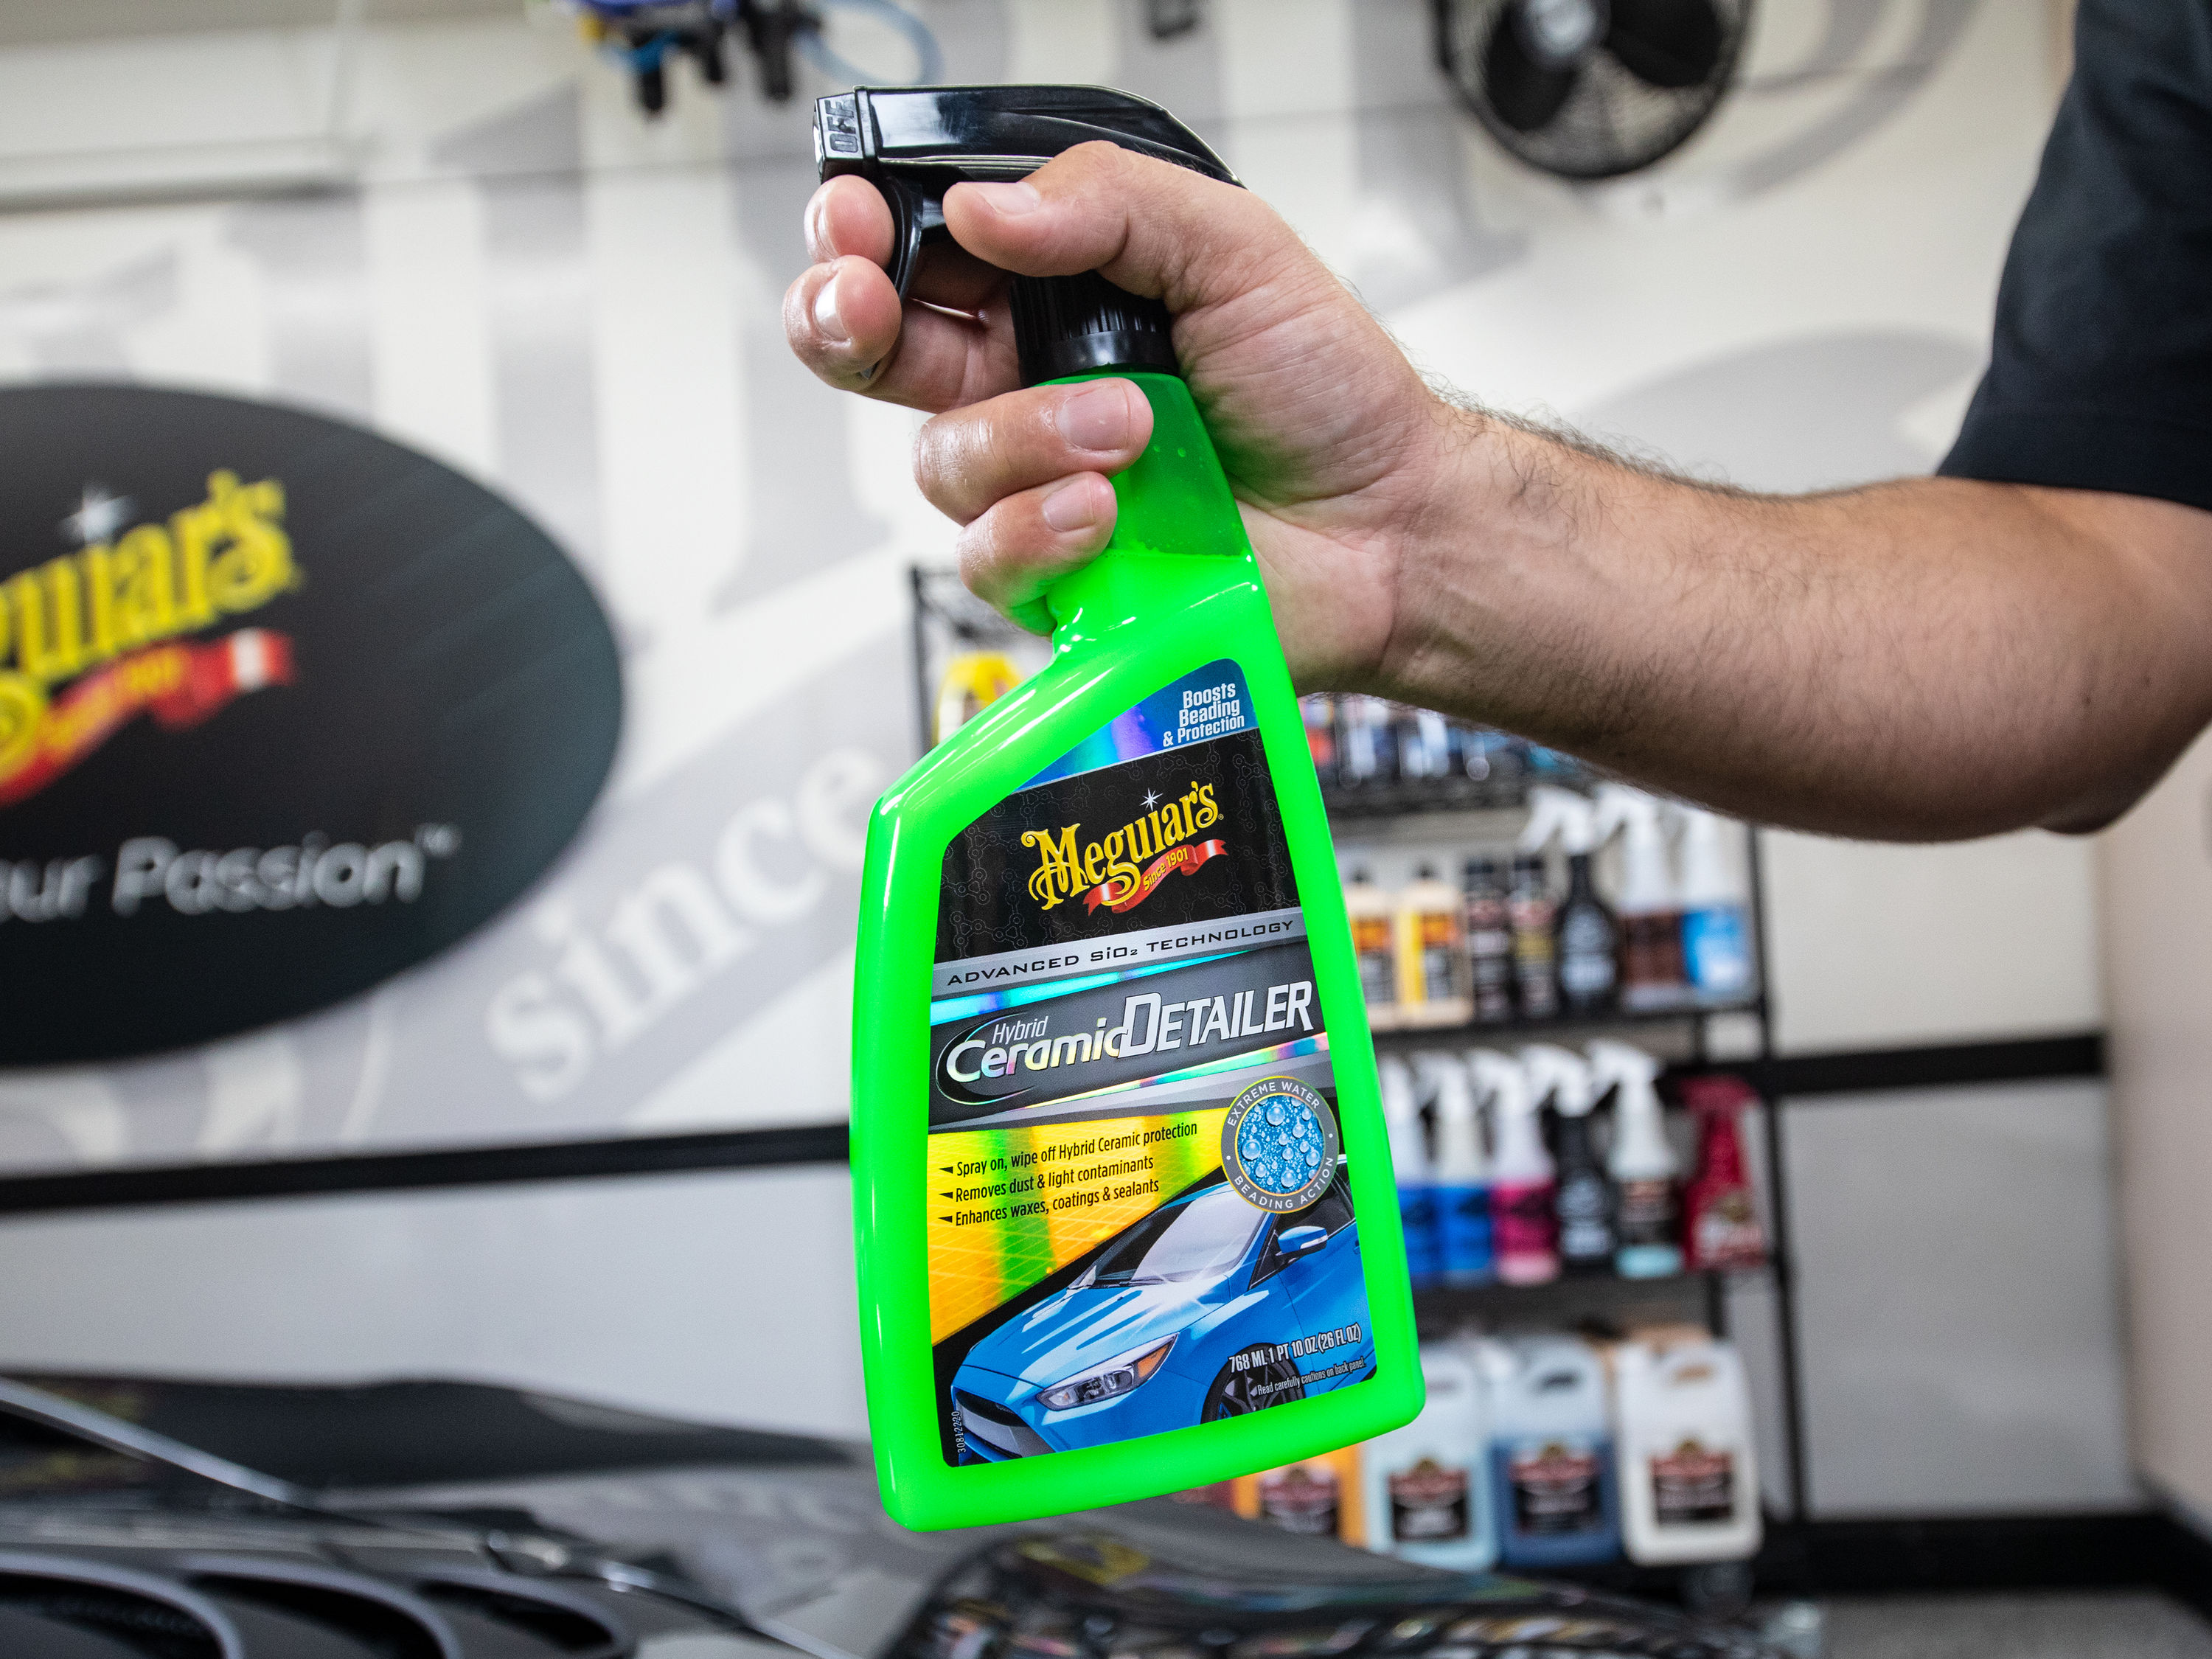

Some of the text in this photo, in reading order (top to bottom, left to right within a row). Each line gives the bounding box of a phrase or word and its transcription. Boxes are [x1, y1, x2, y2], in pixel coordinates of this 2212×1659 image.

[824, 100, 858, 153] OFF
[1179, 699, 1240, 728] Beading
[1183, 683, 1236, 709] Boosts
[1163, 715, 1245, 748] & Protection
[1020, 781, 1219, 911] Meguiar's
[1142, 847, 1189, 892] Since 1901
[0, 830, 425, 923] ur Passion
[487, 747, 884, 1099] since
[947, 955, 1079, 986] ADVANCED
[1147, 920, 1294, 952] TECHNOLOGY
[992, 1015, 1049, 1045] Hybrid
[1227, 1081, 1320, 1126] EXTREME WATER
[957, 1122, 1197, 1178] Spray on, wipe off Hybrid Ceramic protection
[956, 1155, 1153, 1203] Removes dust & light contaminants
[956, 1178, 1159, 1226] Enhances waxes, coatings & sealants
[1235, 1157, 1334, 1209] BEADING ACTION
[1228, 1322, 1362, 1373] 768 ML 1 PT 10 OZ (26 FL OZ)
[1257, 1356, 1366, 1396] Read carefully cautions on back panel.
[951, 1411, 966, 1453] 30812220
